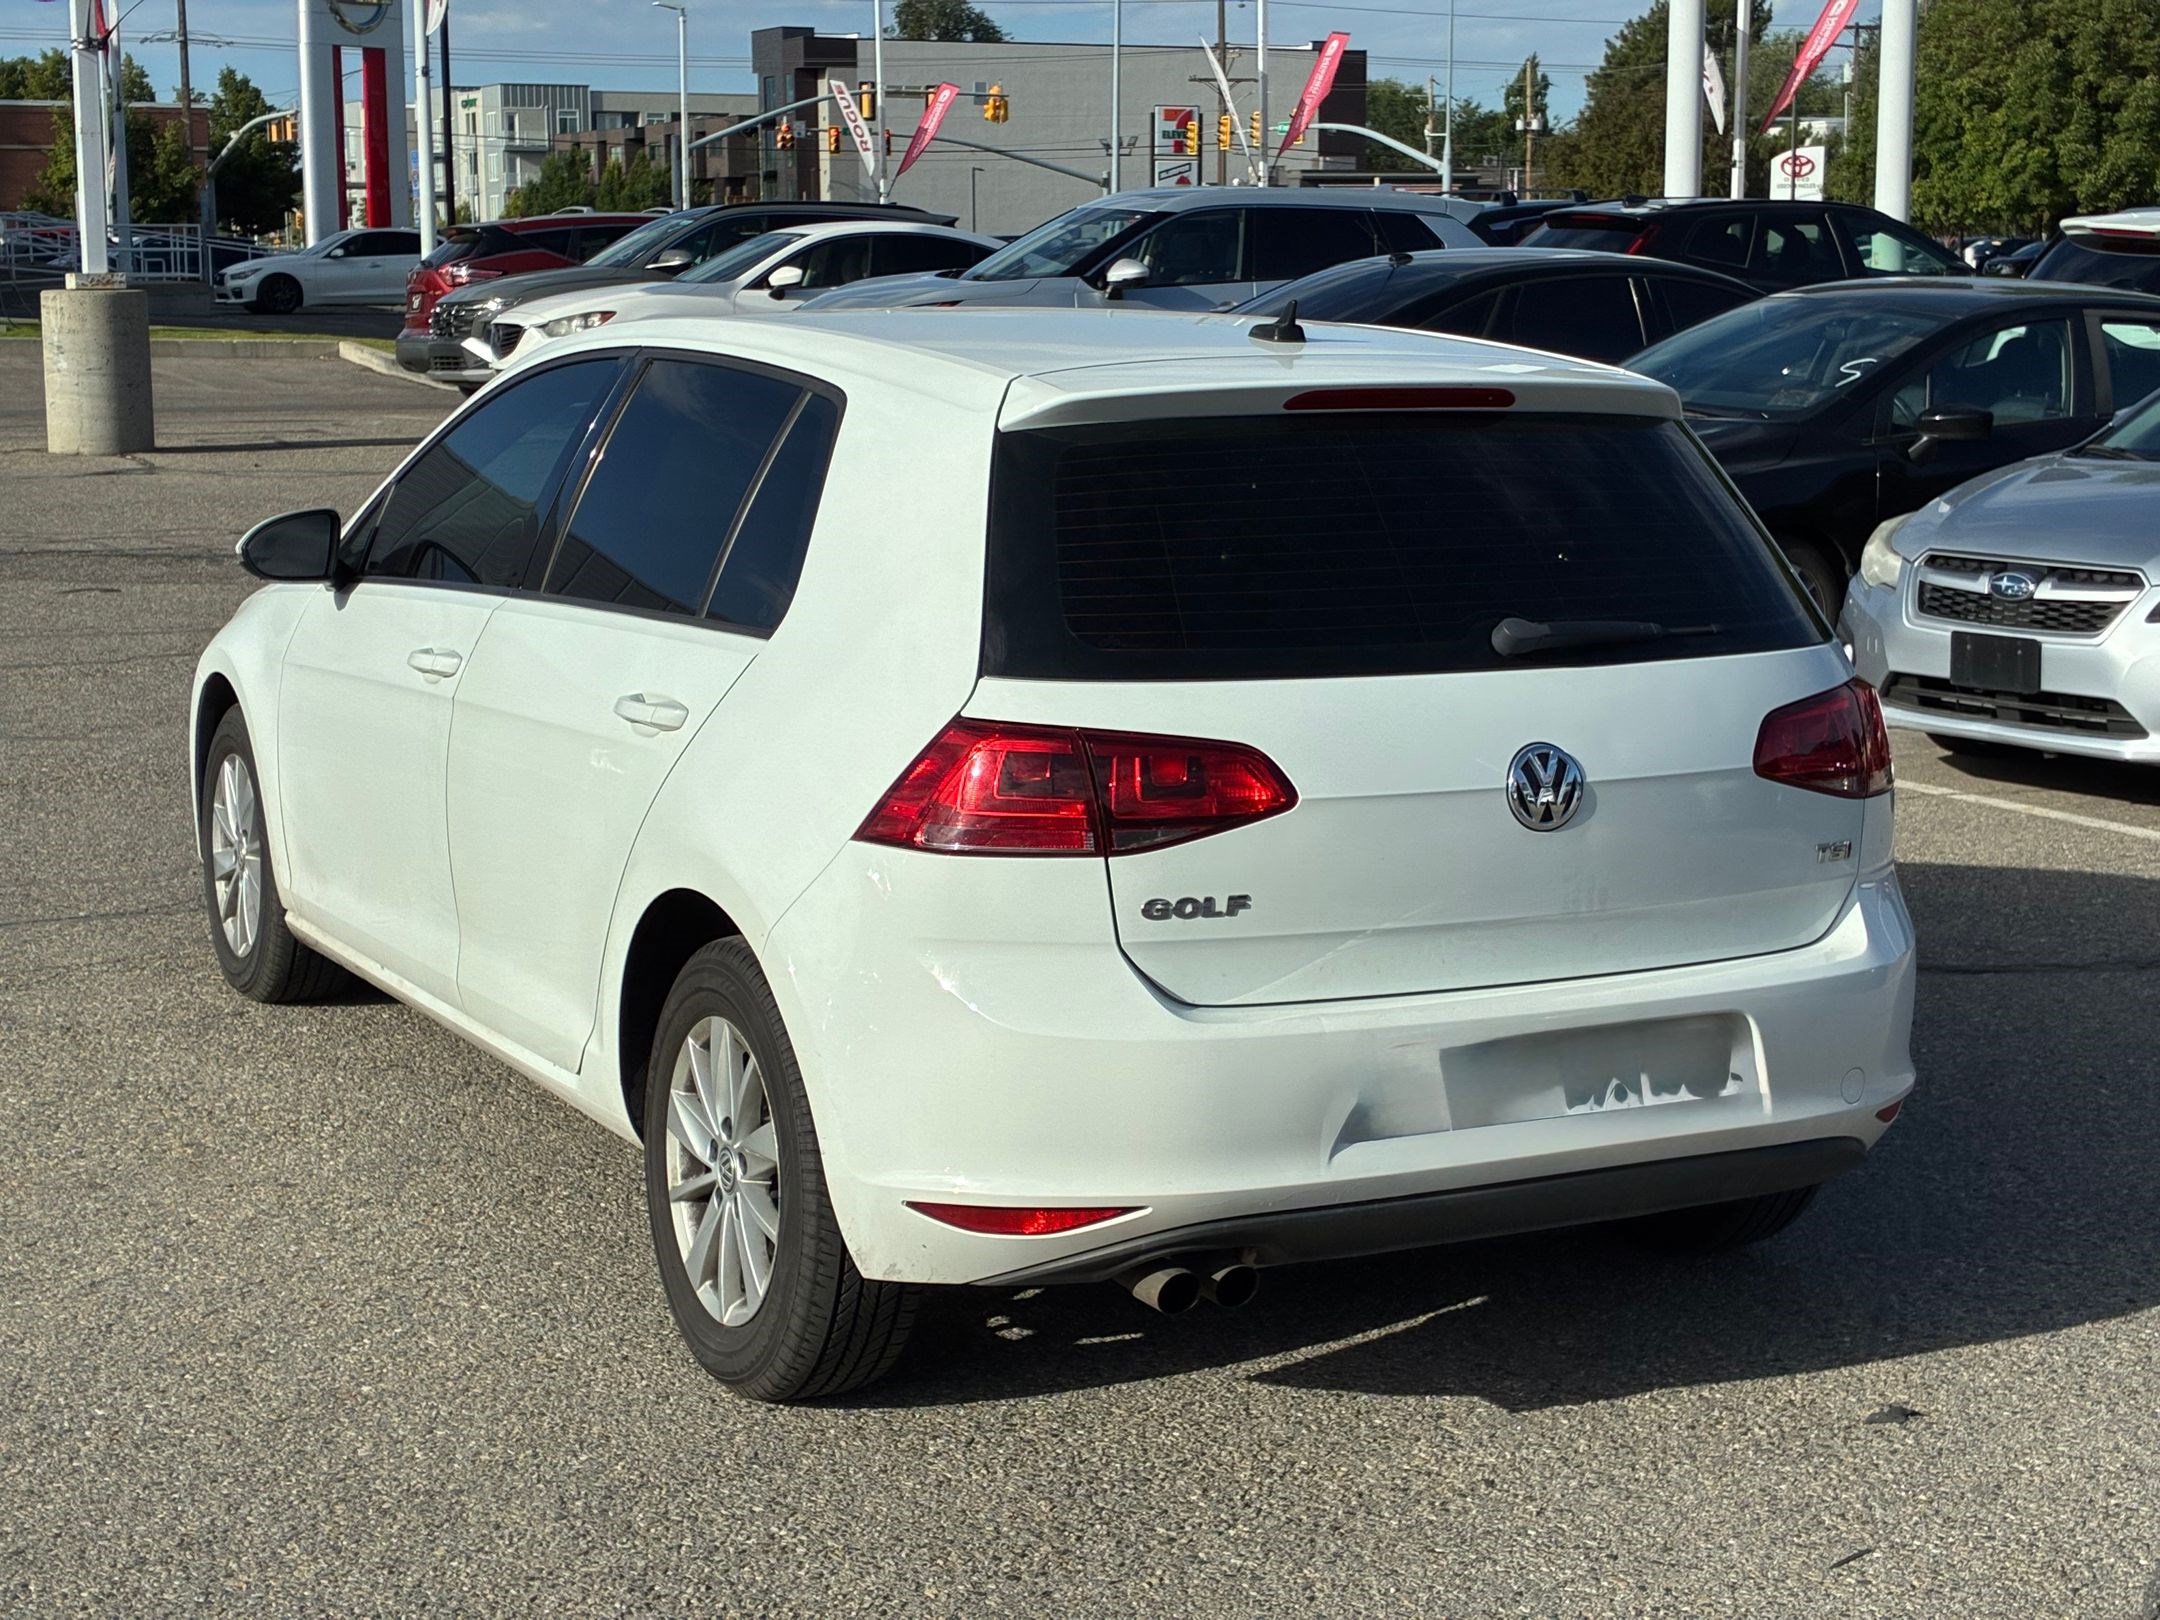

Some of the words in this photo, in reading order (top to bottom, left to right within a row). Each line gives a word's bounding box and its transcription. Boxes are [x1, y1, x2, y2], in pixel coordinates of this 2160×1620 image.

[833, 84, 872, 153] ROGUE
[1162, 130, 1189, 139] ELEV
[1815, 840, 1852, 864] TSI
[1141, 894, 1252, 921] GOLF
